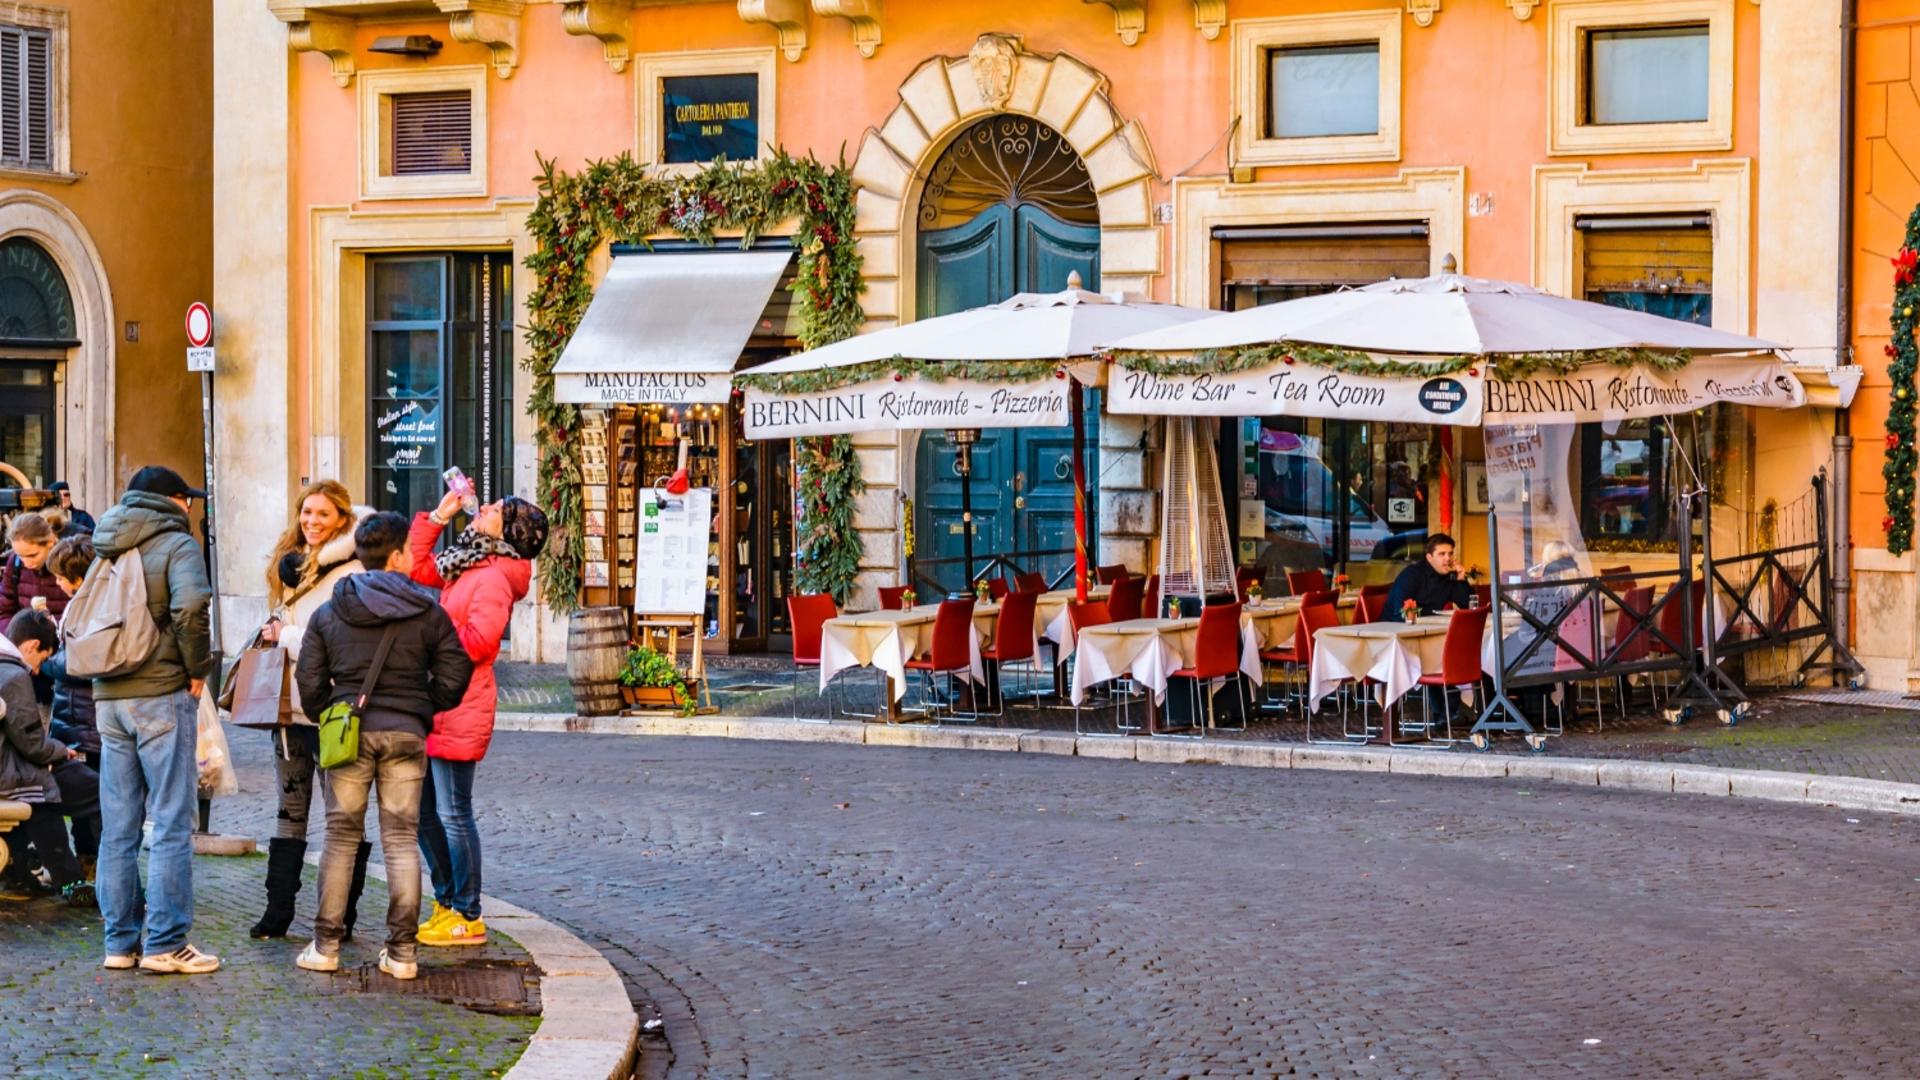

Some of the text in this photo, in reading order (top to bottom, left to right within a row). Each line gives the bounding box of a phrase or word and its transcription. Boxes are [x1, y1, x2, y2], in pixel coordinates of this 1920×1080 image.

[676, 101, 750, 122] CARTOLERIA PANTHEON
[585, 372, 706, 388] MANUFACTUS
[1125, 372, 1184, 401] Wine
[1191, 374, 1236, 402] Bar
[1269, 372, 1308, 401] Tea
[1317, 374, 1386, 408] Room
[601, 388, 687, 400] MADE IN ITALY
[1486, 378, 1598, 413] BERNINI
[750, 393, 865, 427] BERNINI
[877, 390, 969, 420] Ristorante
[990, 388, 1064, 414] Pizzeria
[418, 420, 435, 432] food
